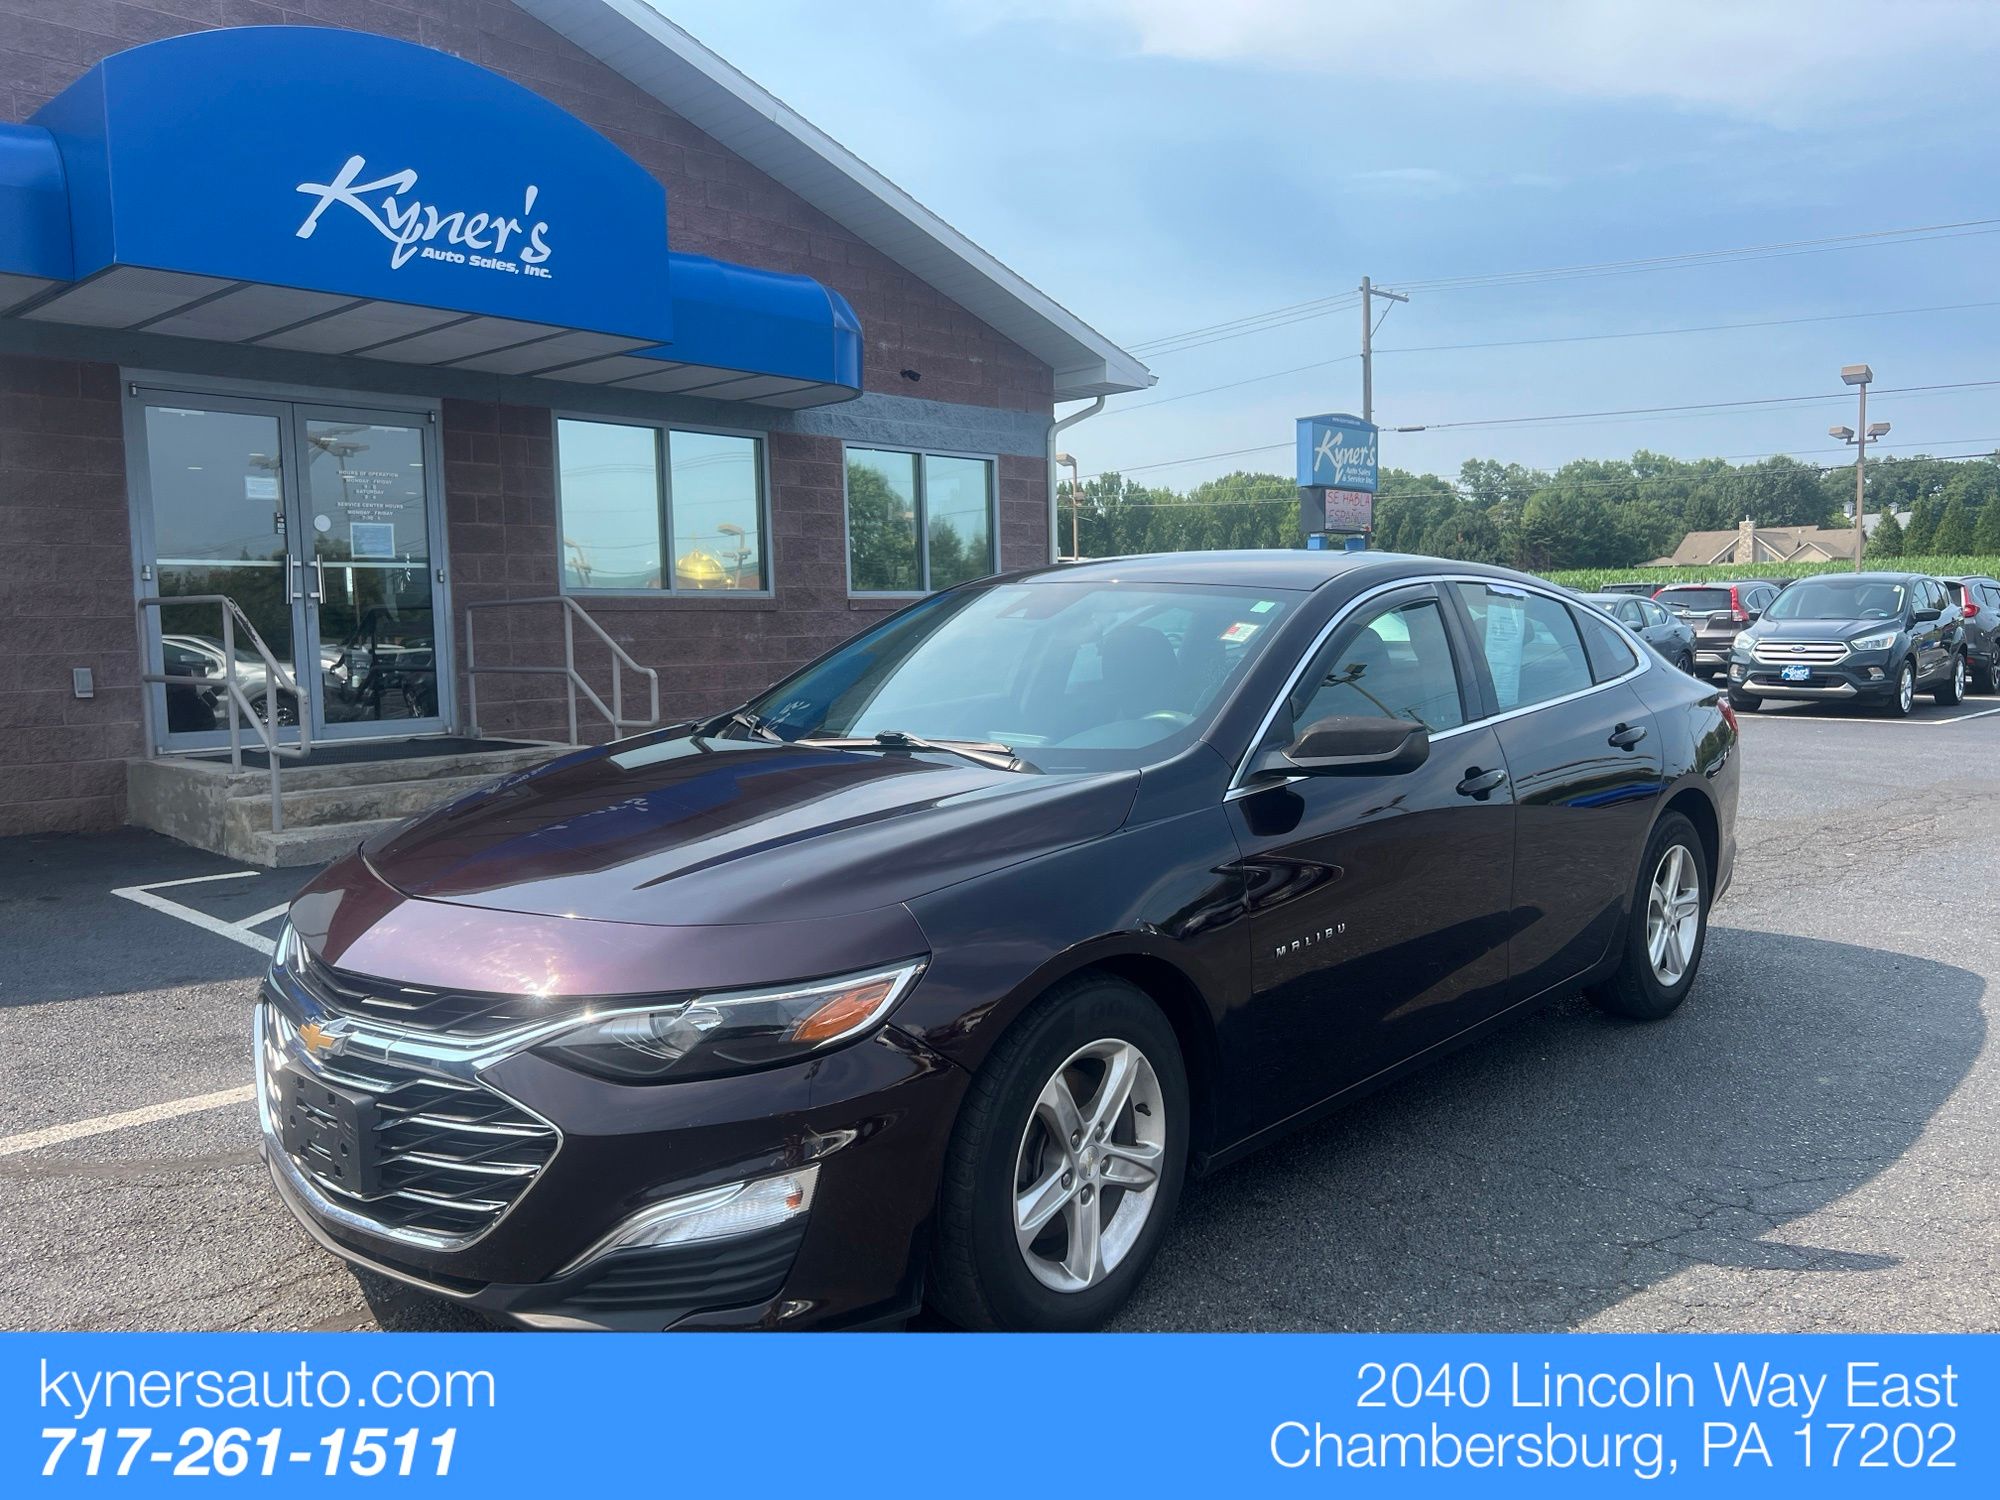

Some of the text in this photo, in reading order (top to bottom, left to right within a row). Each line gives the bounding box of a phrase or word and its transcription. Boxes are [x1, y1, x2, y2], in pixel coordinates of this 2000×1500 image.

[296, 155, 552, 270] Kyner's
[421, 247, 552, 278] Auto Sales, Inc.
[1314, 429, 1376, 484] Kyner's
[1327, 491, 1370, 506] SE HABLA
[1276, 923, 1345, 958] MALIBU
